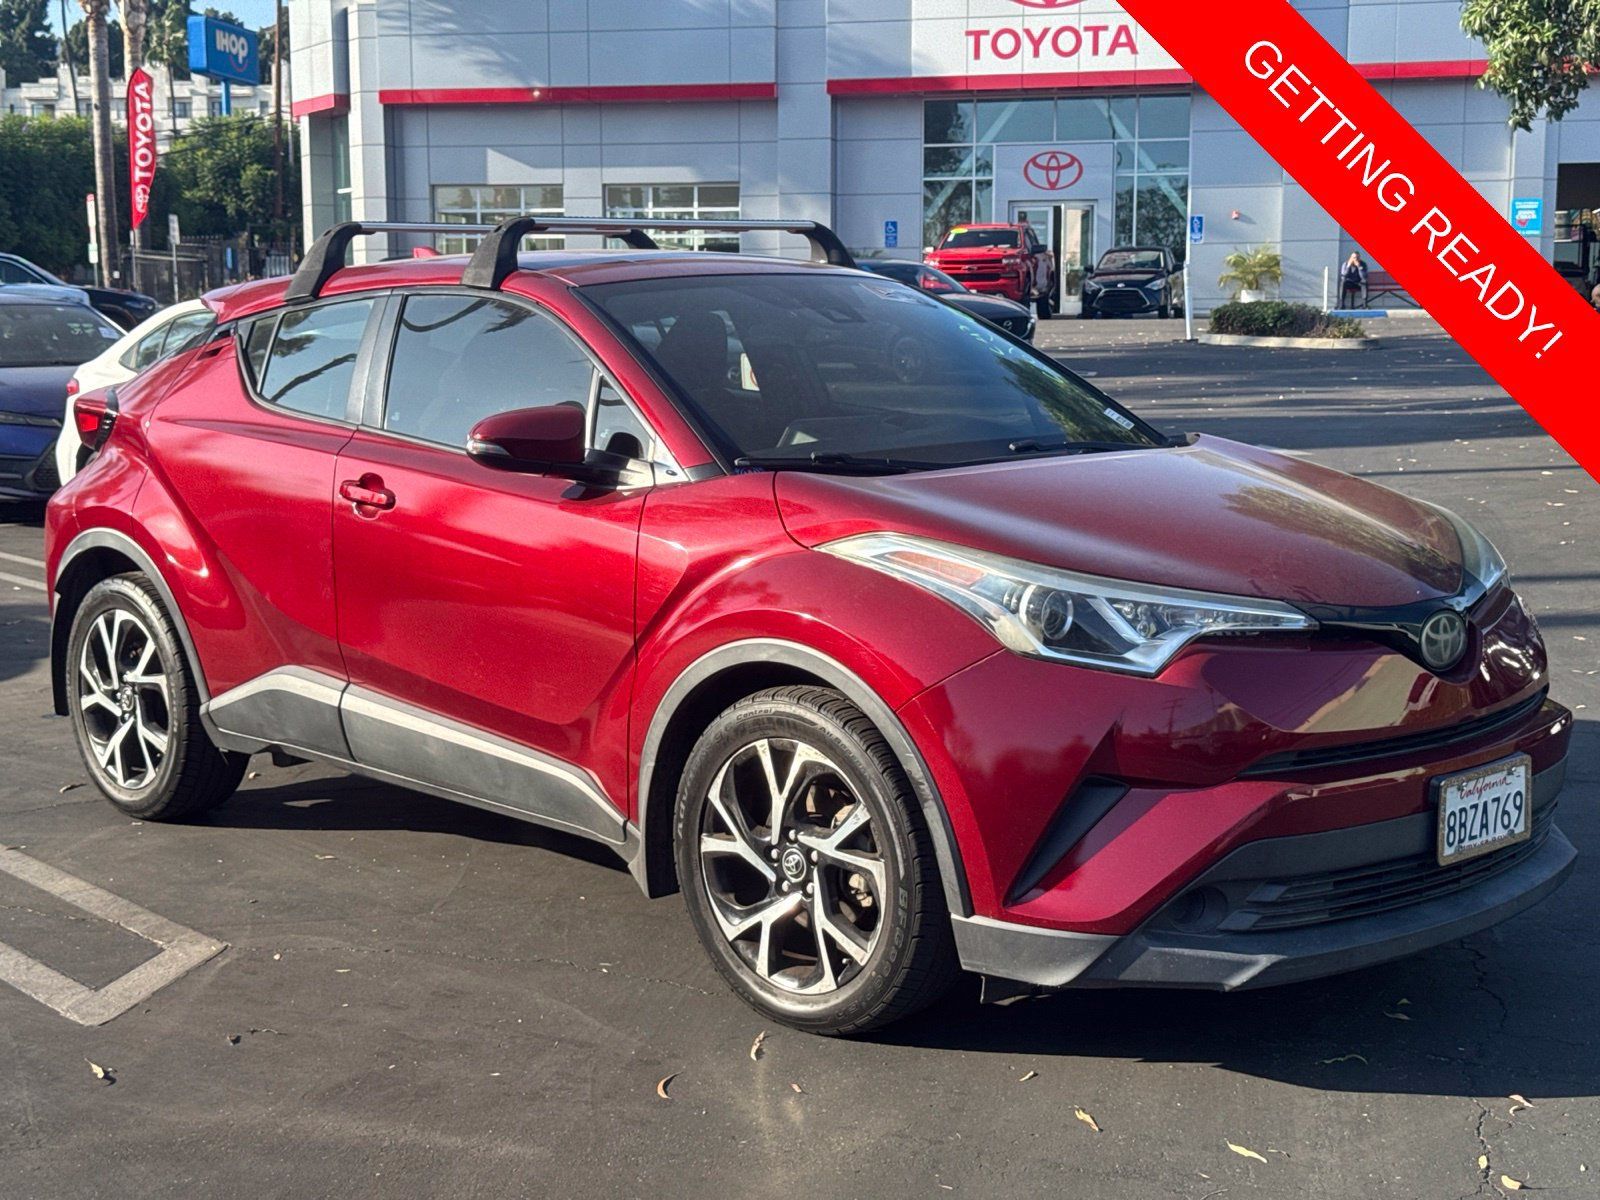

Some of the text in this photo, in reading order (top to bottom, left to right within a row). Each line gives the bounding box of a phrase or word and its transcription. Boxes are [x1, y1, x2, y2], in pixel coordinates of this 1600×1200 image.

[966, 25, 1138, 60] TOYOTA
[134, 81, 153, 183] TOYOTA
[1458, 776, 1512, 800] California
[1446, 790, 1524, 848] 8BZA769
